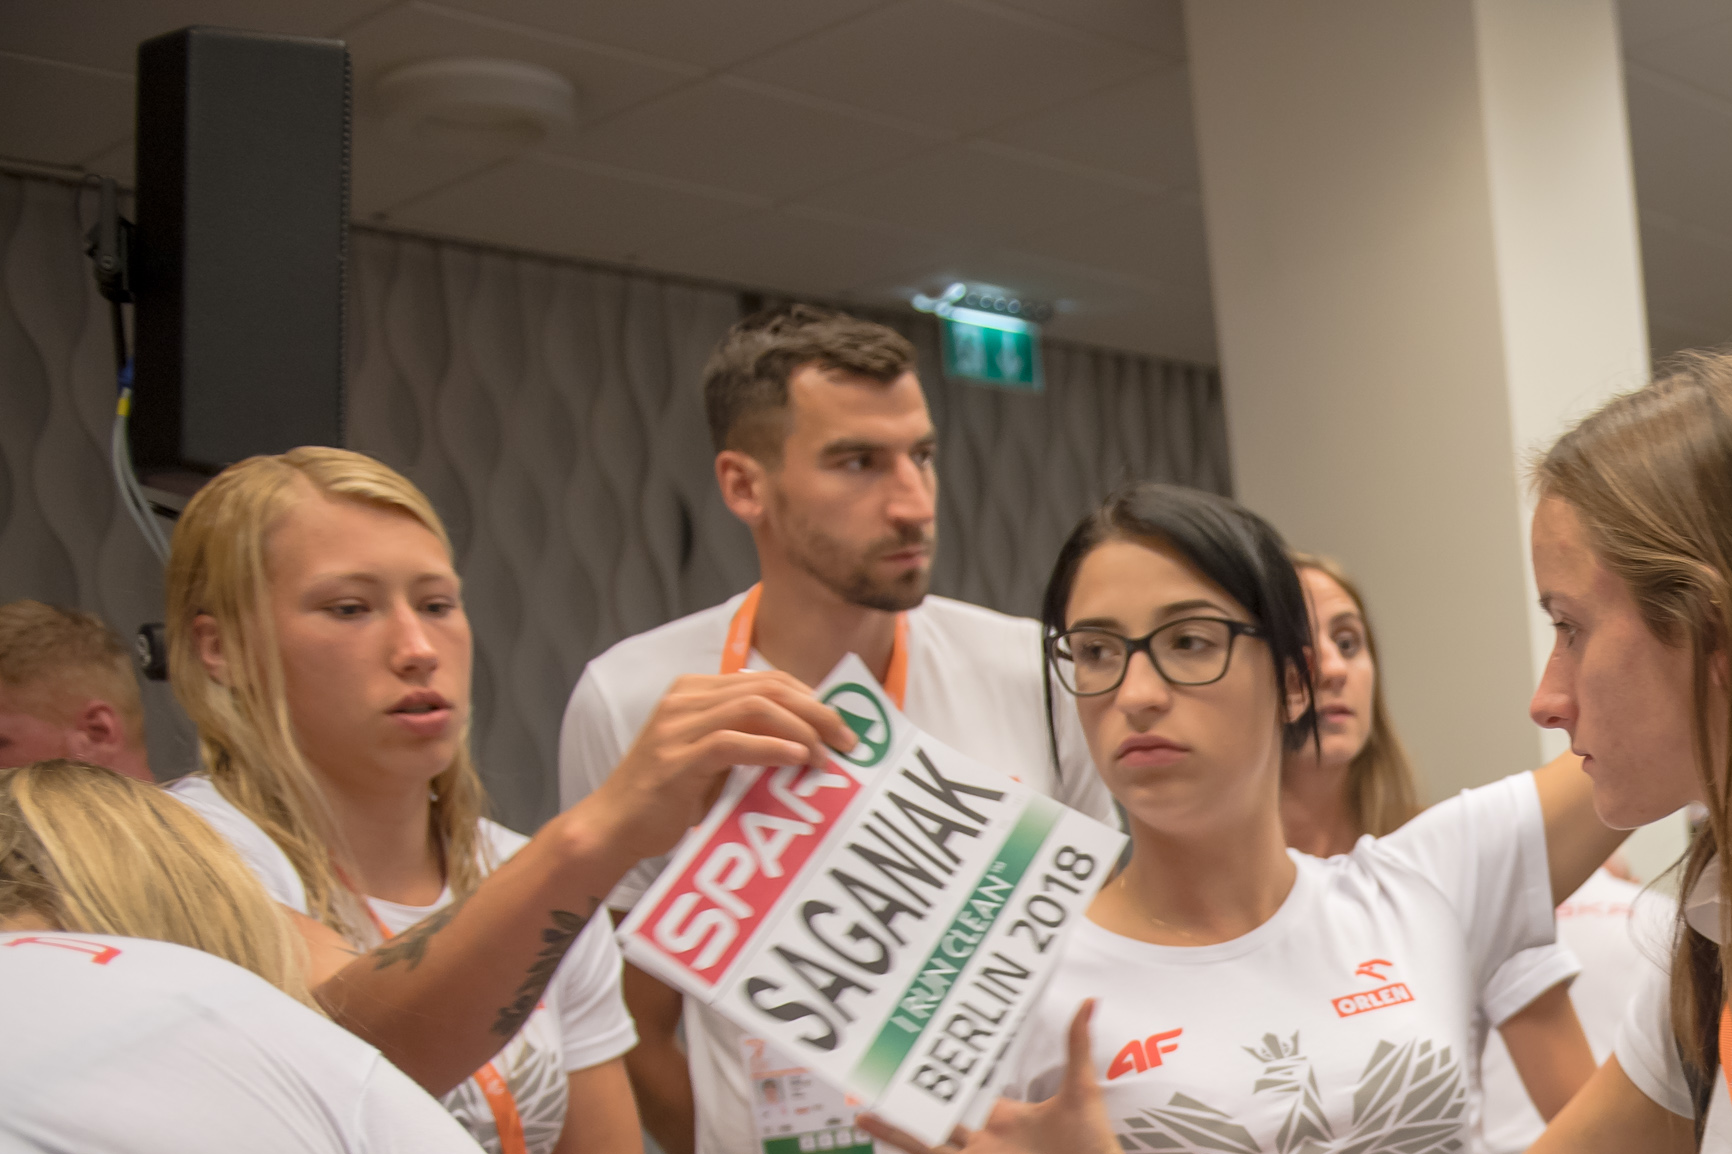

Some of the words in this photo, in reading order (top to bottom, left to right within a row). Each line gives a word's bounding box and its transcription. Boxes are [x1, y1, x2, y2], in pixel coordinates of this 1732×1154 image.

[741, 746, 1006, 1052] SAGANIAK
[911, 952, 1030, 1105] BERLIN
[1008, 845, 1095, 954] 2018
[902, 966, 946, 1020] RUN
[1337, 984, 1409, 1016] ORLEN
